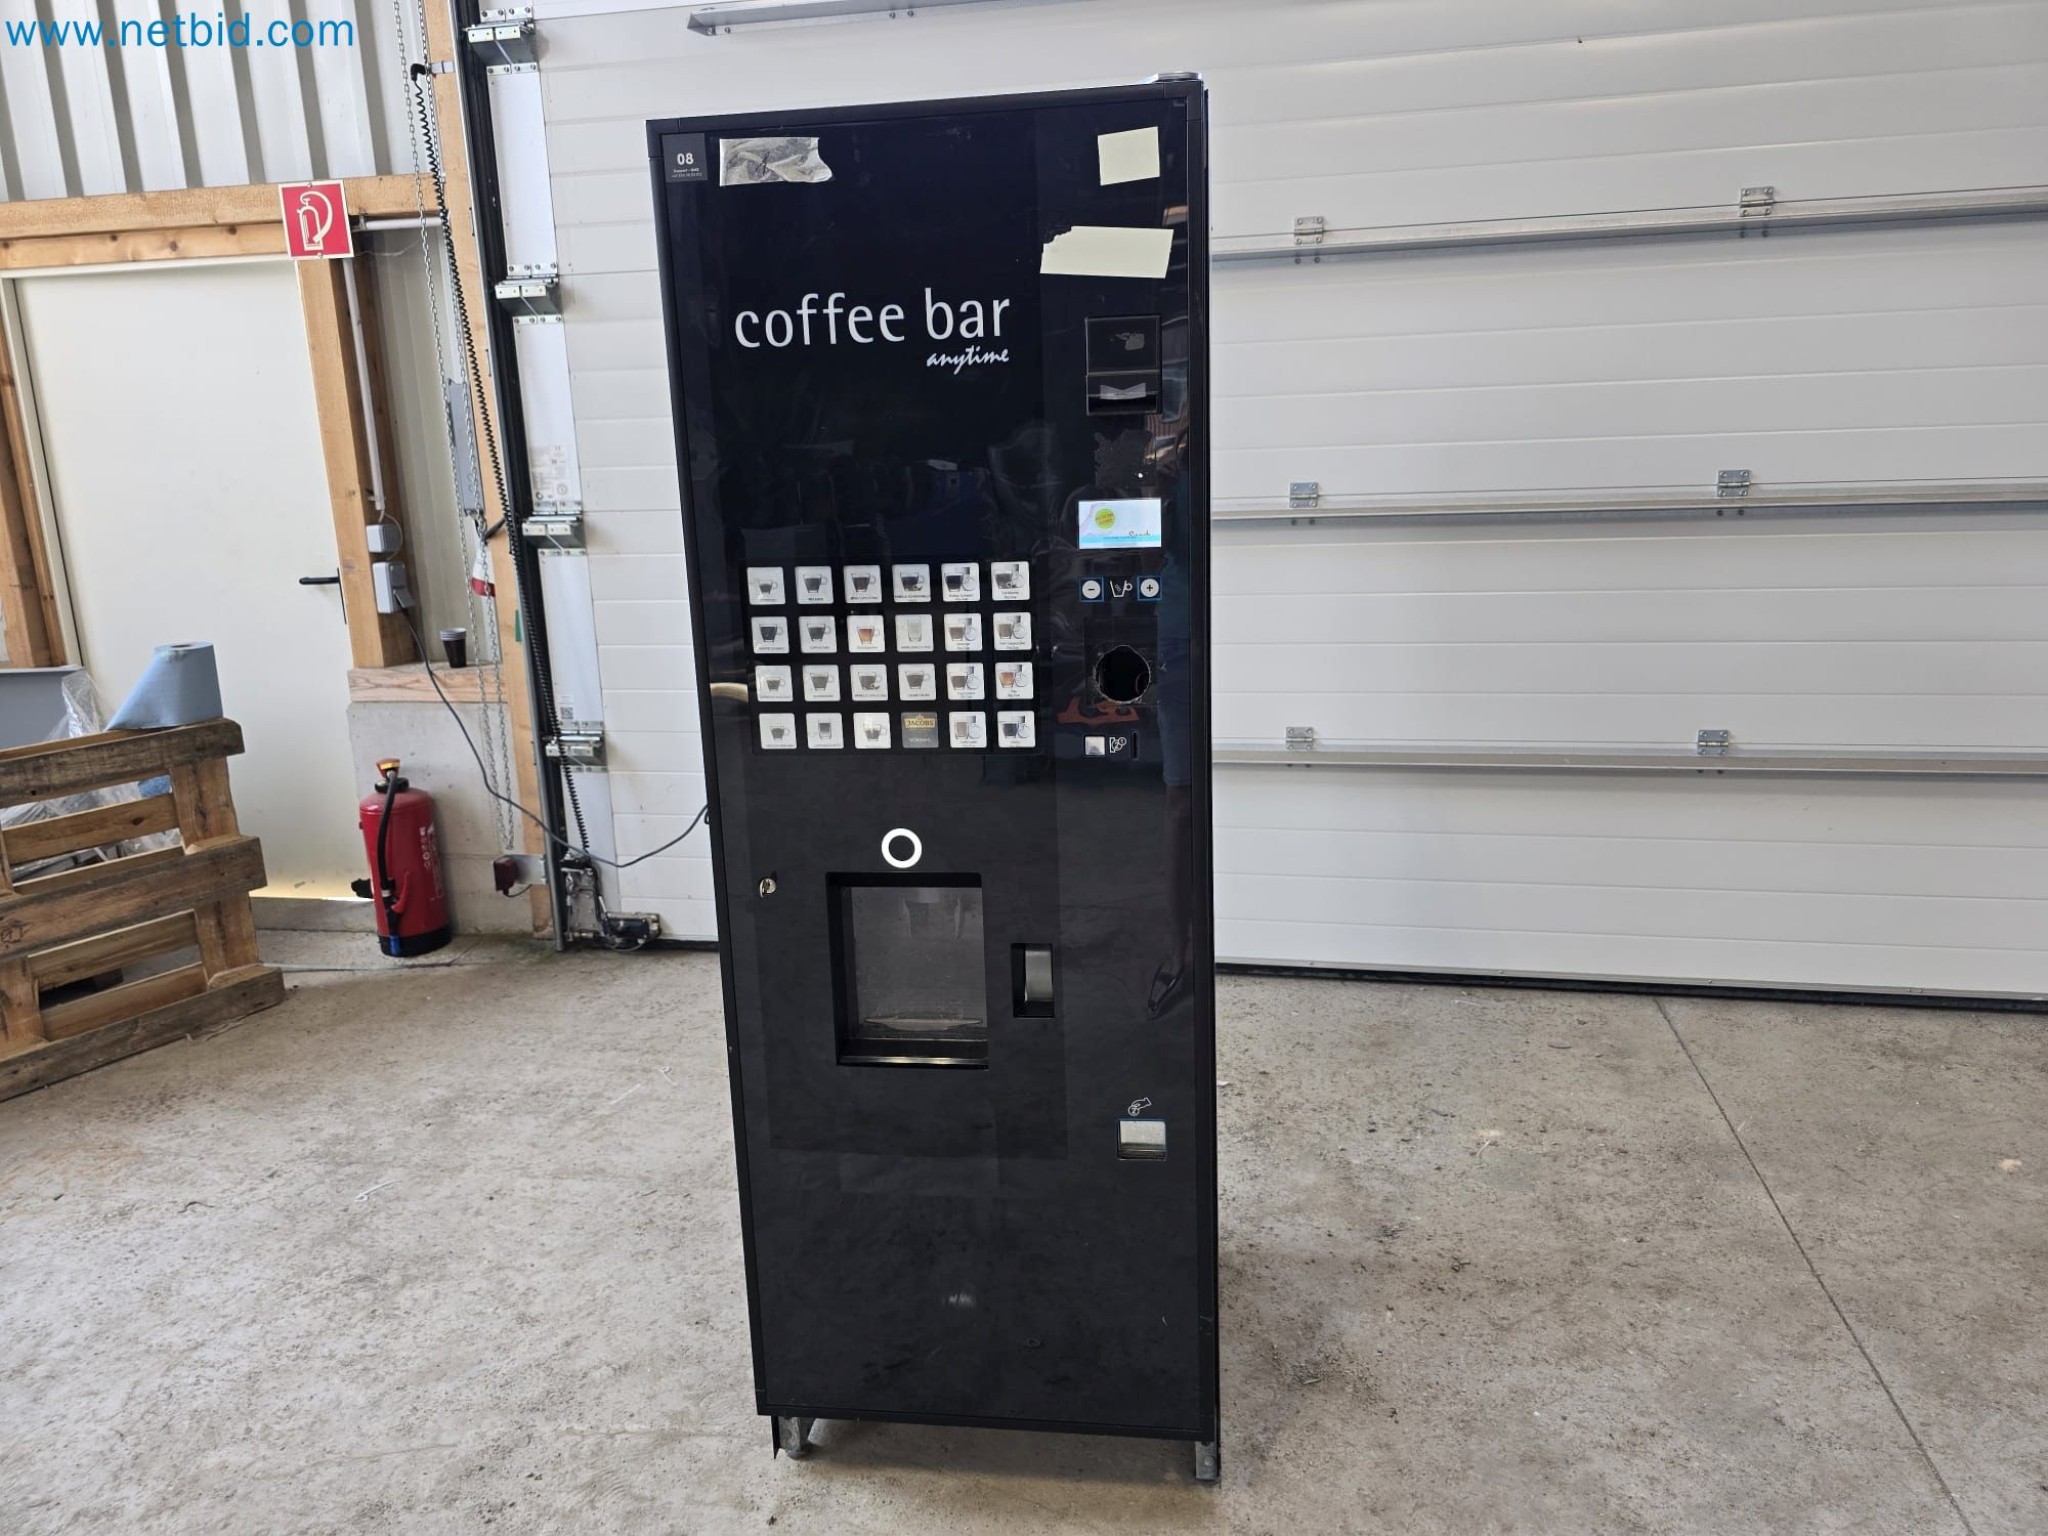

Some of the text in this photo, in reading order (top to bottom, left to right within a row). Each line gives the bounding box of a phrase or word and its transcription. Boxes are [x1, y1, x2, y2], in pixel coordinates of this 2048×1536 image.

[676, 152, 694, 165] 08
[735, 287, 1010, 348] coffee bar
[926, 345, 1010, 375] anytime
